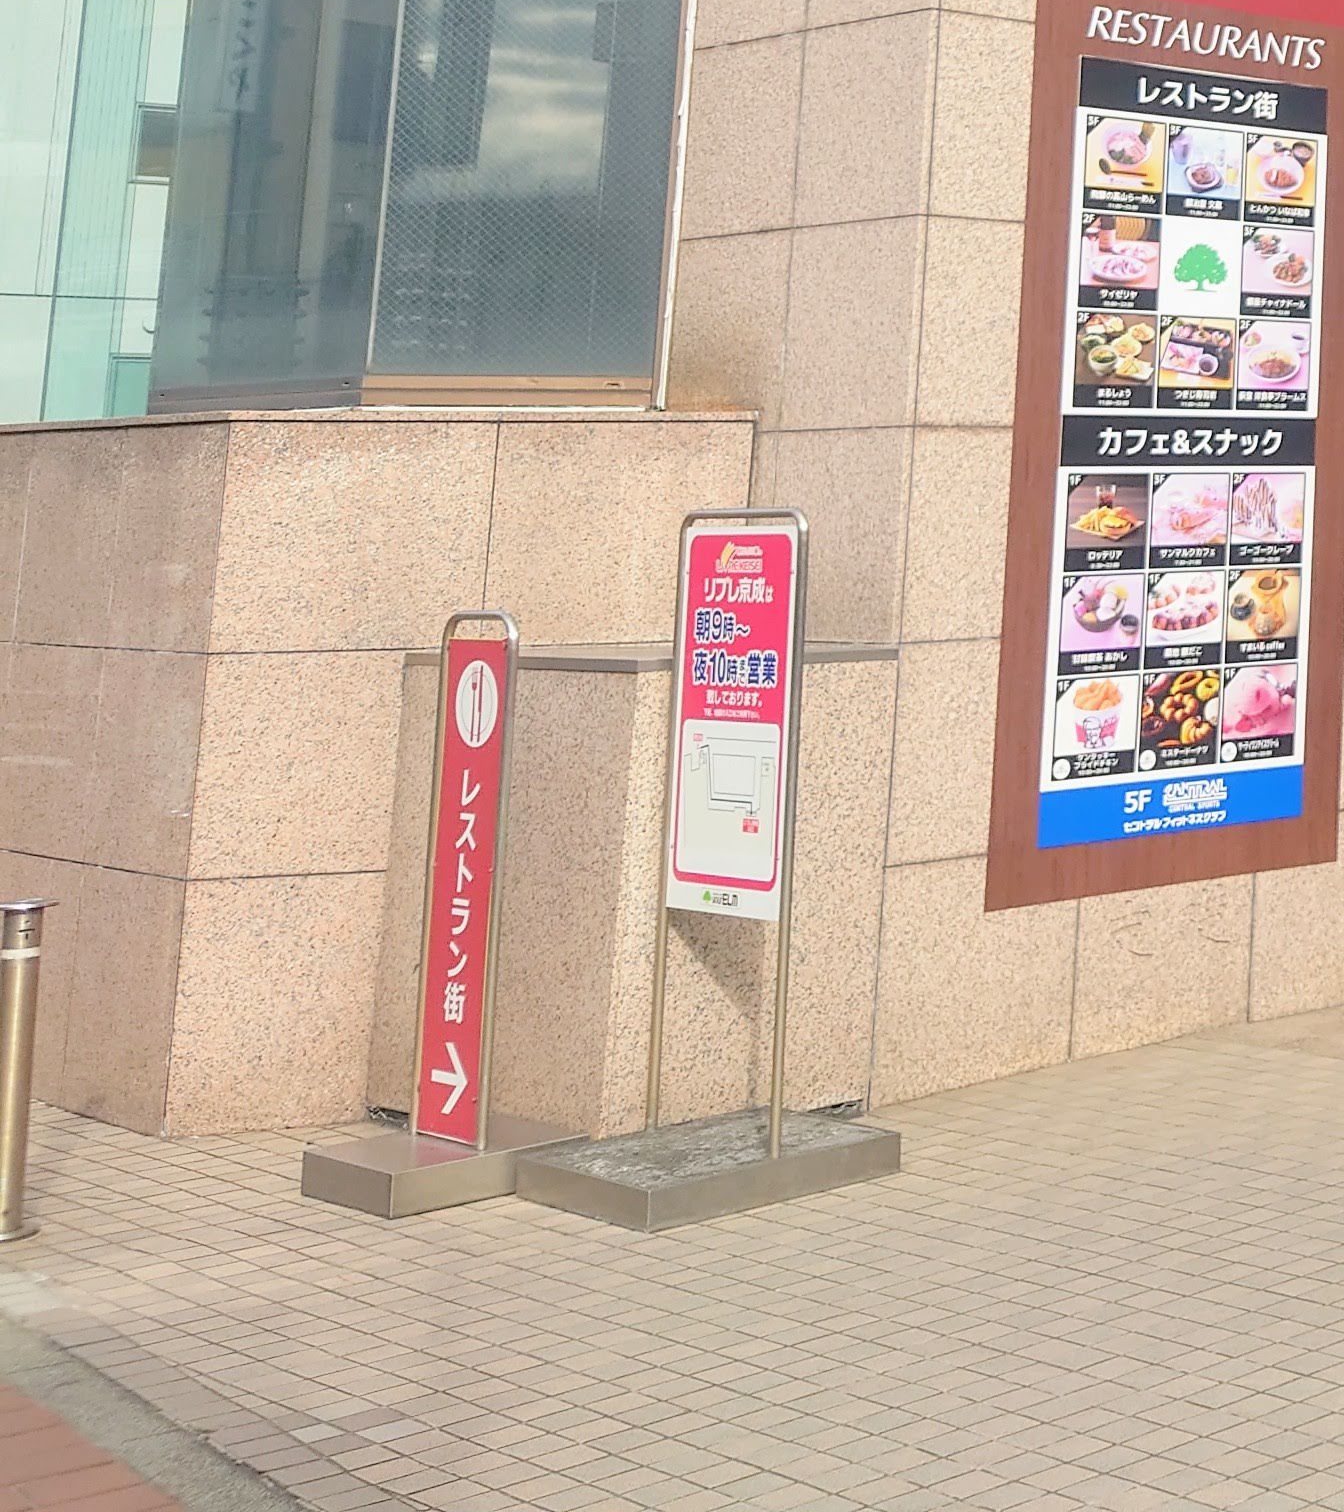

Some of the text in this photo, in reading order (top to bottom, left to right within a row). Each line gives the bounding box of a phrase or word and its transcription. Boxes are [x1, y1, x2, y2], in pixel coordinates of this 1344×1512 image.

[1085, 6, 1326, 70] RESTAURANTS
[1137, 76, 1279, 120] レストラン街
[1097, 427, 1284, 458] カフェ&スナック
[1124, 789, 1152, 814] 5F
[443, 768, 482, 1025] レストラン街
